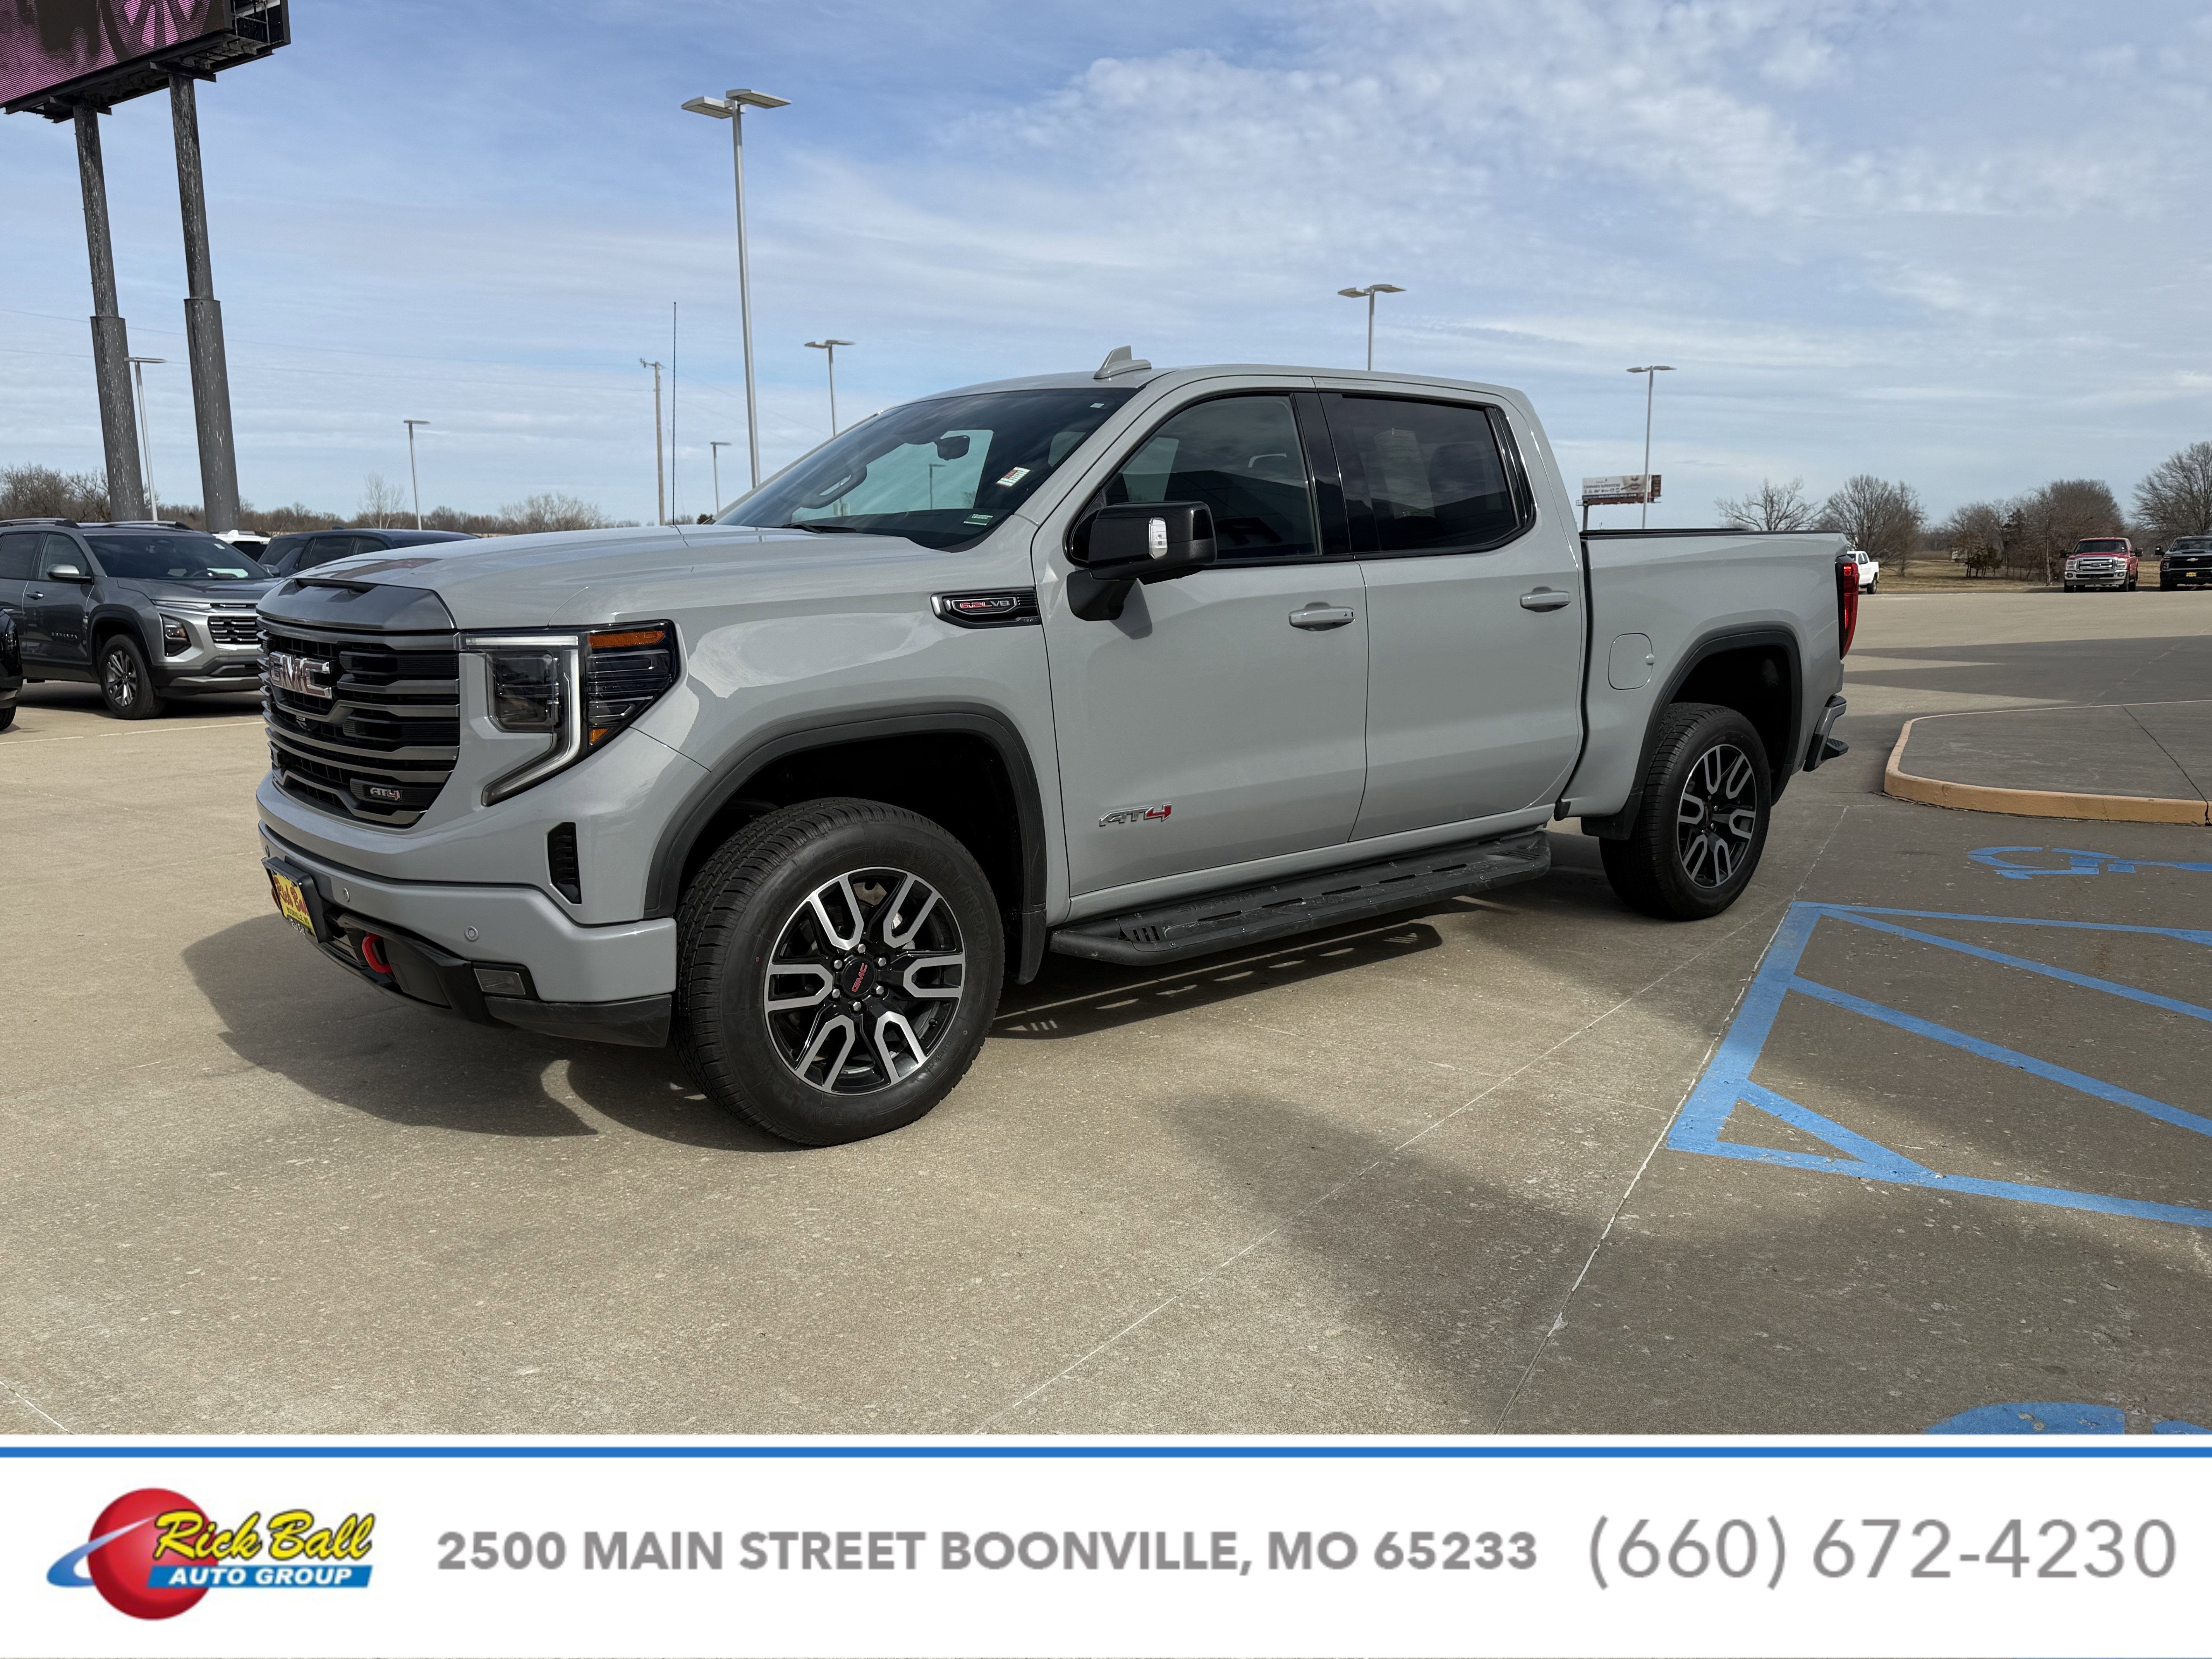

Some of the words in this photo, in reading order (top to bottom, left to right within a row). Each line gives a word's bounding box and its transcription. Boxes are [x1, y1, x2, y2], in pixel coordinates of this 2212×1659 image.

[269, 651, 332, 700] GMC
[370, 787, 400, 801] AT4
[1099, 804, 1172, 827] AT4
[851, 963, 868, 992] GMC
